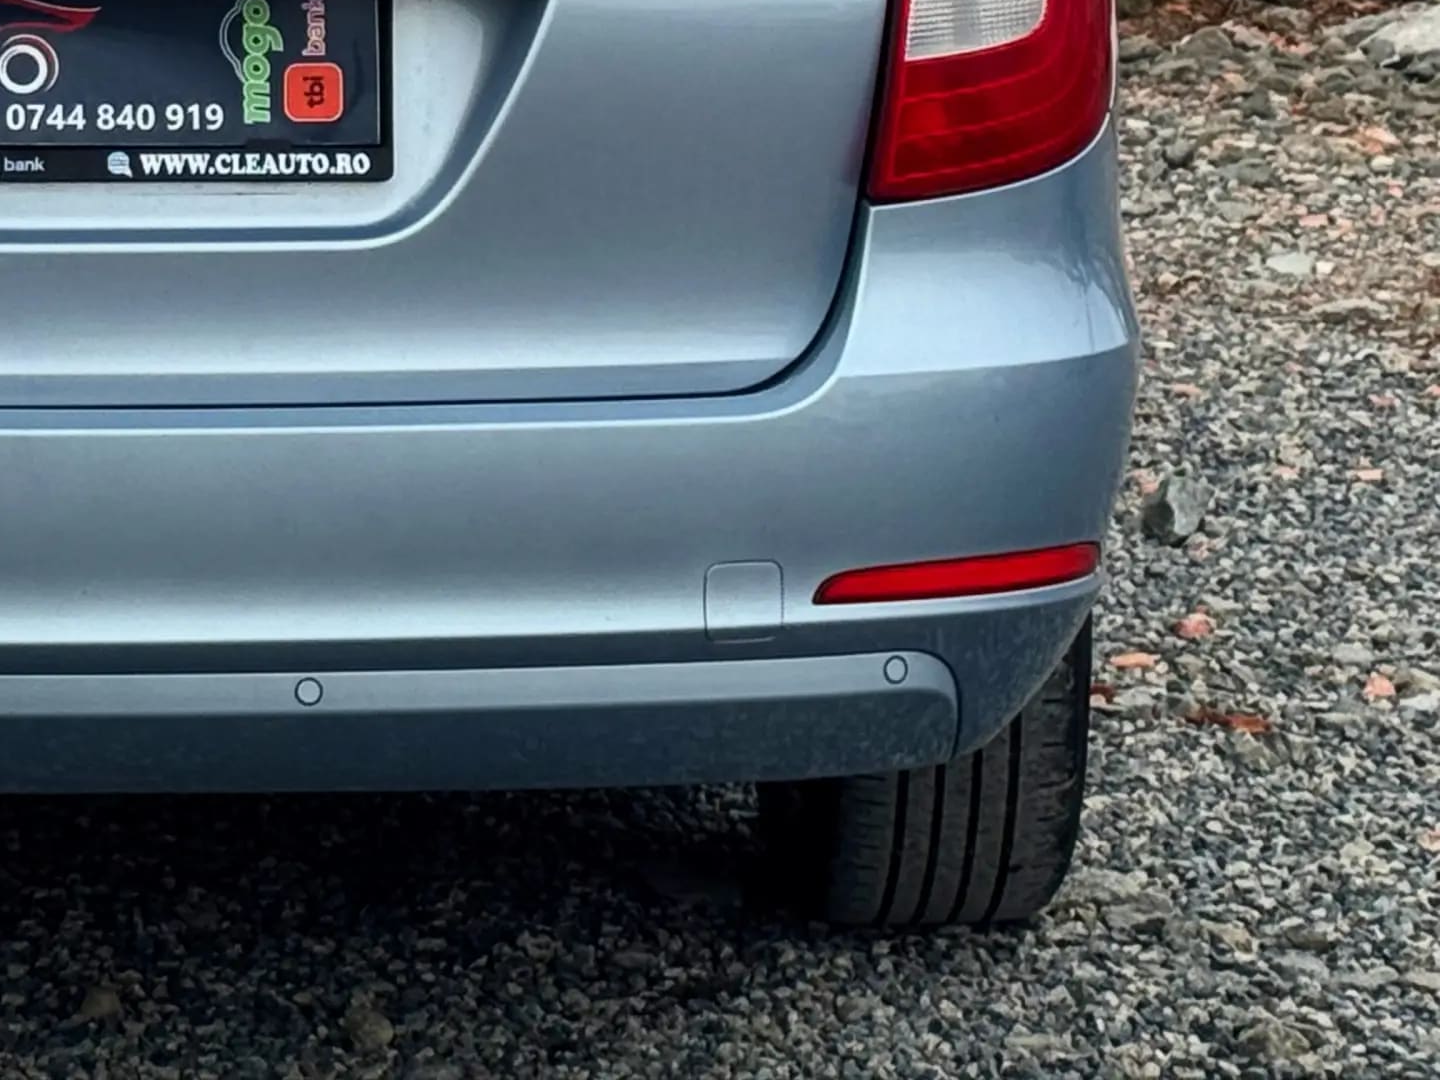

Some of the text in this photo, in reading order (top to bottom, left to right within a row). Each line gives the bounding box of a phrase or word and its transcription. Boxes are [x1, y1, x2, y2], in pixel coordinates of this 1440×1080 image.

[6, 103, 224, 131] 0744 840 919
[4, 156, 45, 171] bank
[139, 152, 371, 176] WWW.CLEAUTO.RO
